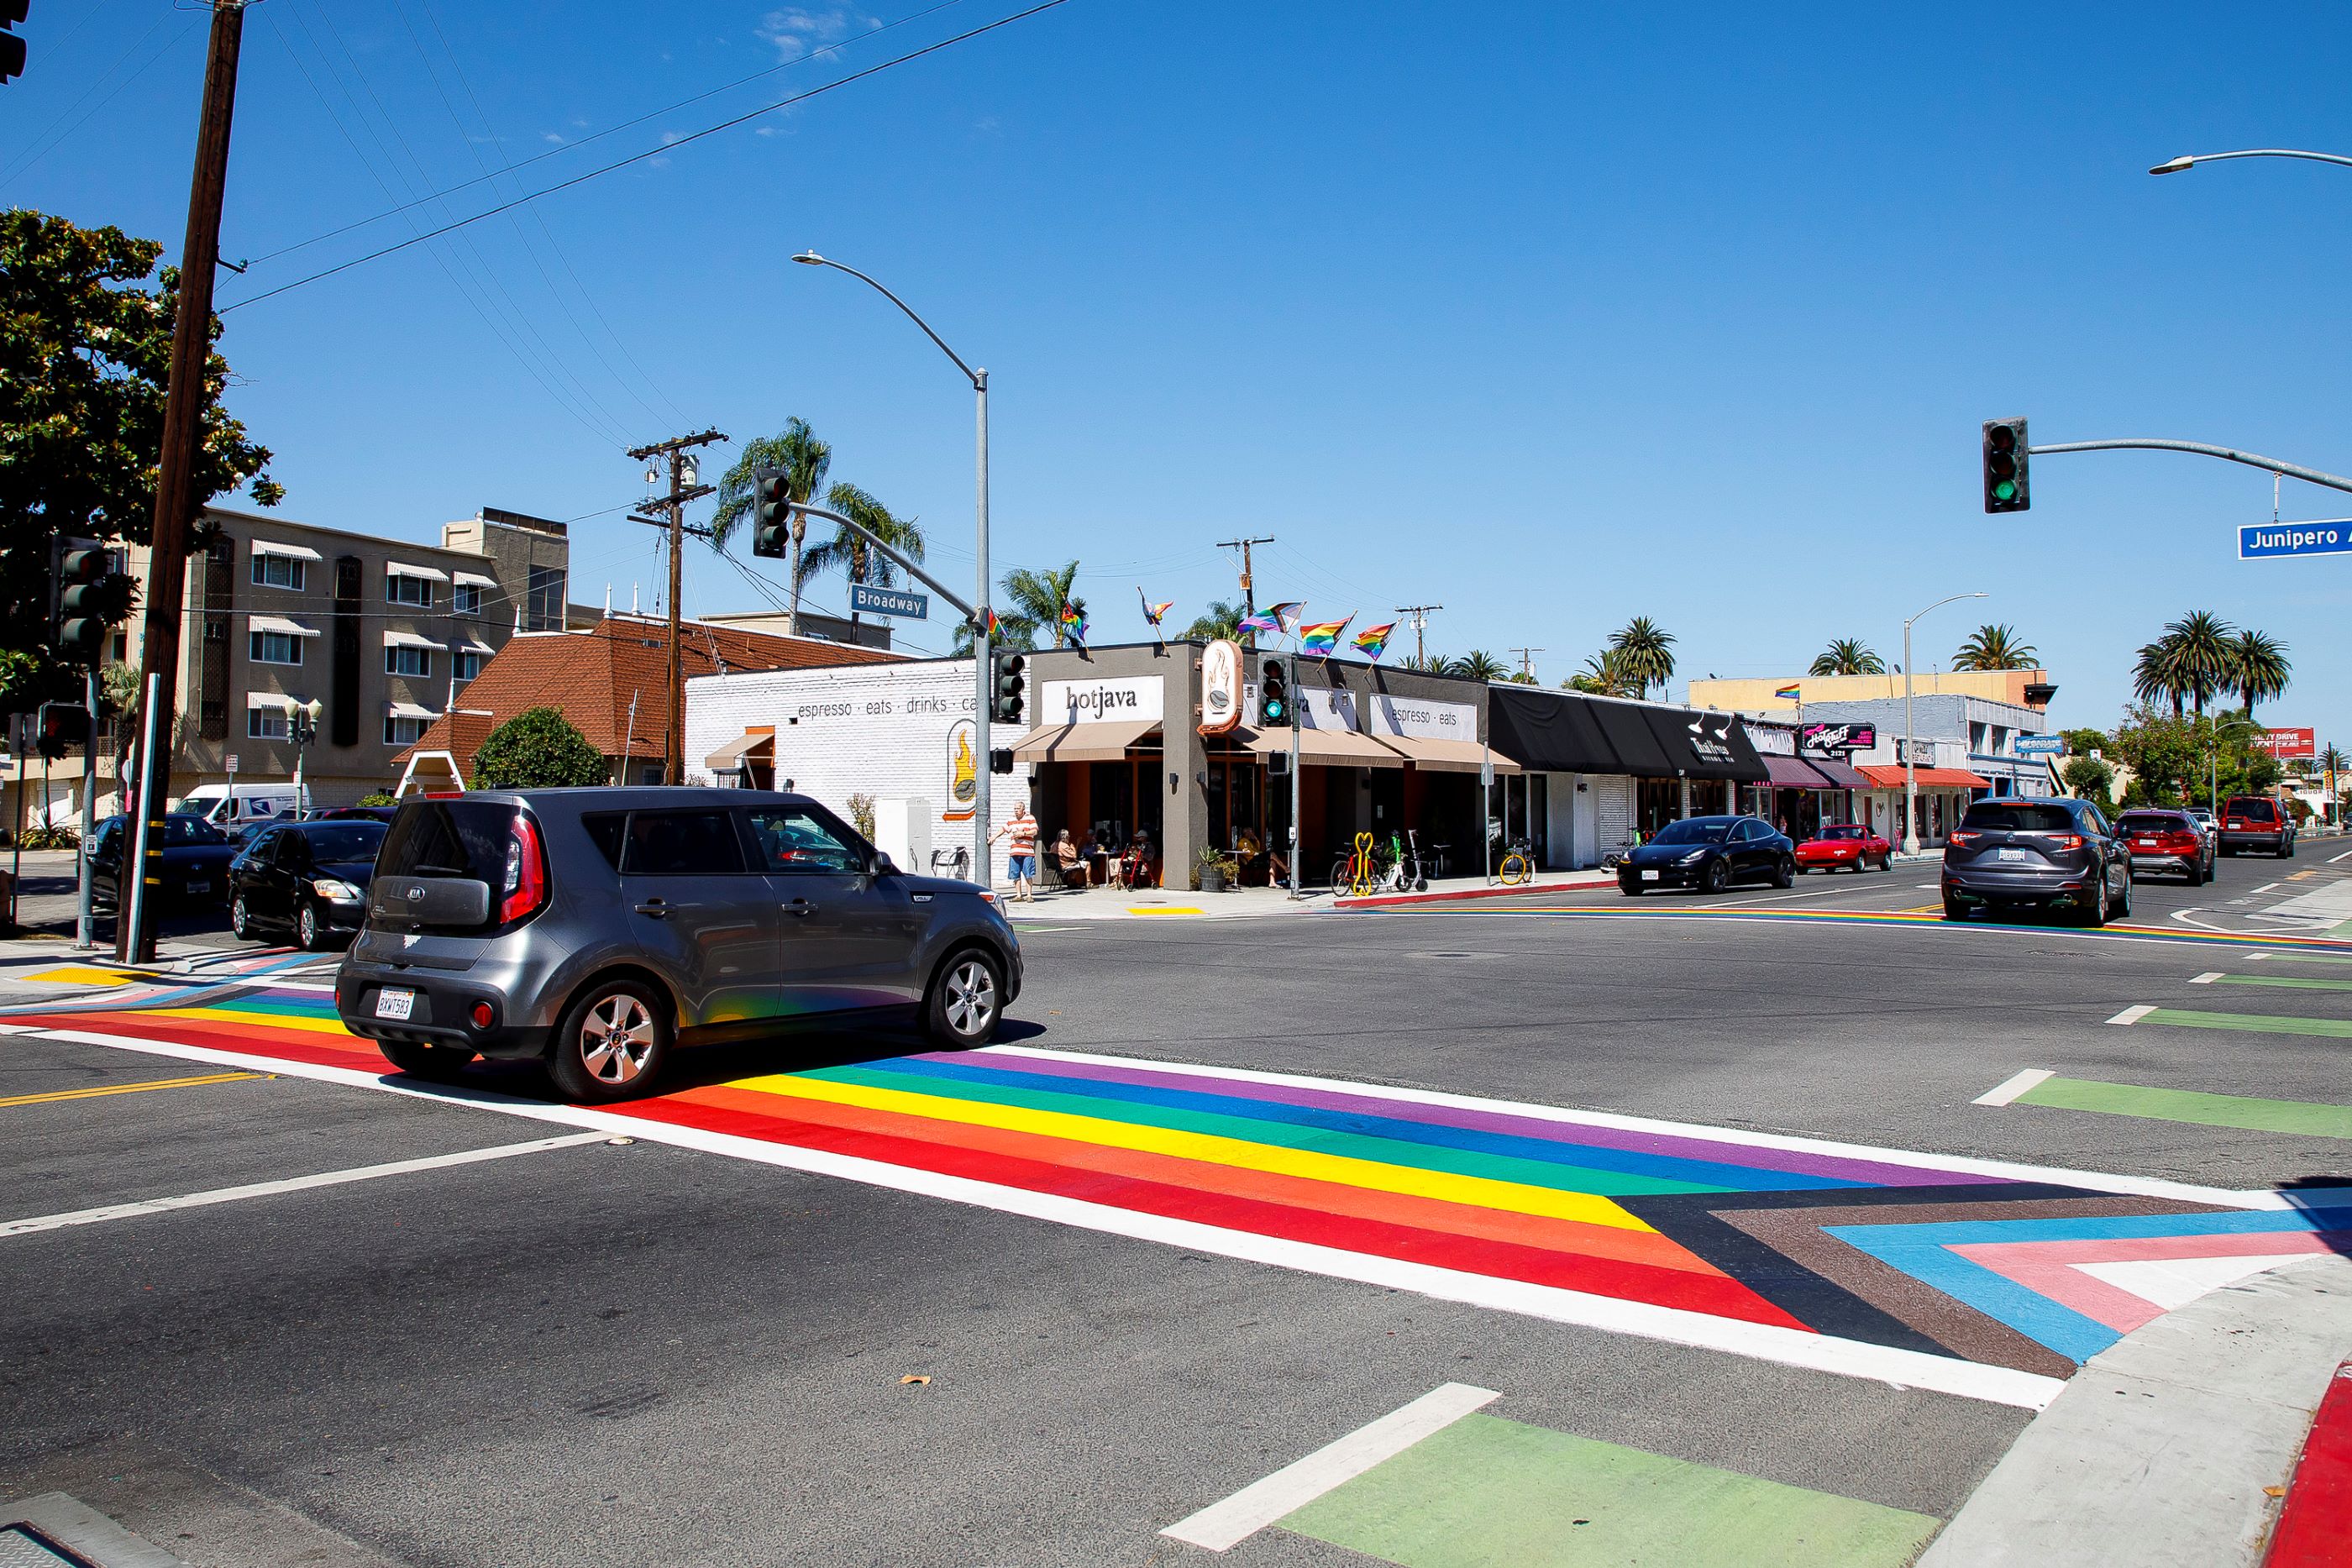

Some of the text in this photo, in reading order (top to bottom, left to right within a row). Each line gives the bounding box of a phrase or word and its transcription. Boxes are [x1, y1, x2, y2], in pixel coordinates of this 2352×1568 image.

[2249, 529, 2338, 550] Junipero
[858, 590, 921, 616] Broadway
[798, 700, 852, 721] espresso
[866, 699, 892, 714] eats
[906, 695, 947, 714] drinks
[1066, 686, 1137, 719] hotjava
[1391, 709, 1457, 726] espresso eats
[409, 889, 421, 899] KIA
[379, 998, 410, 1015] 8XWT583
